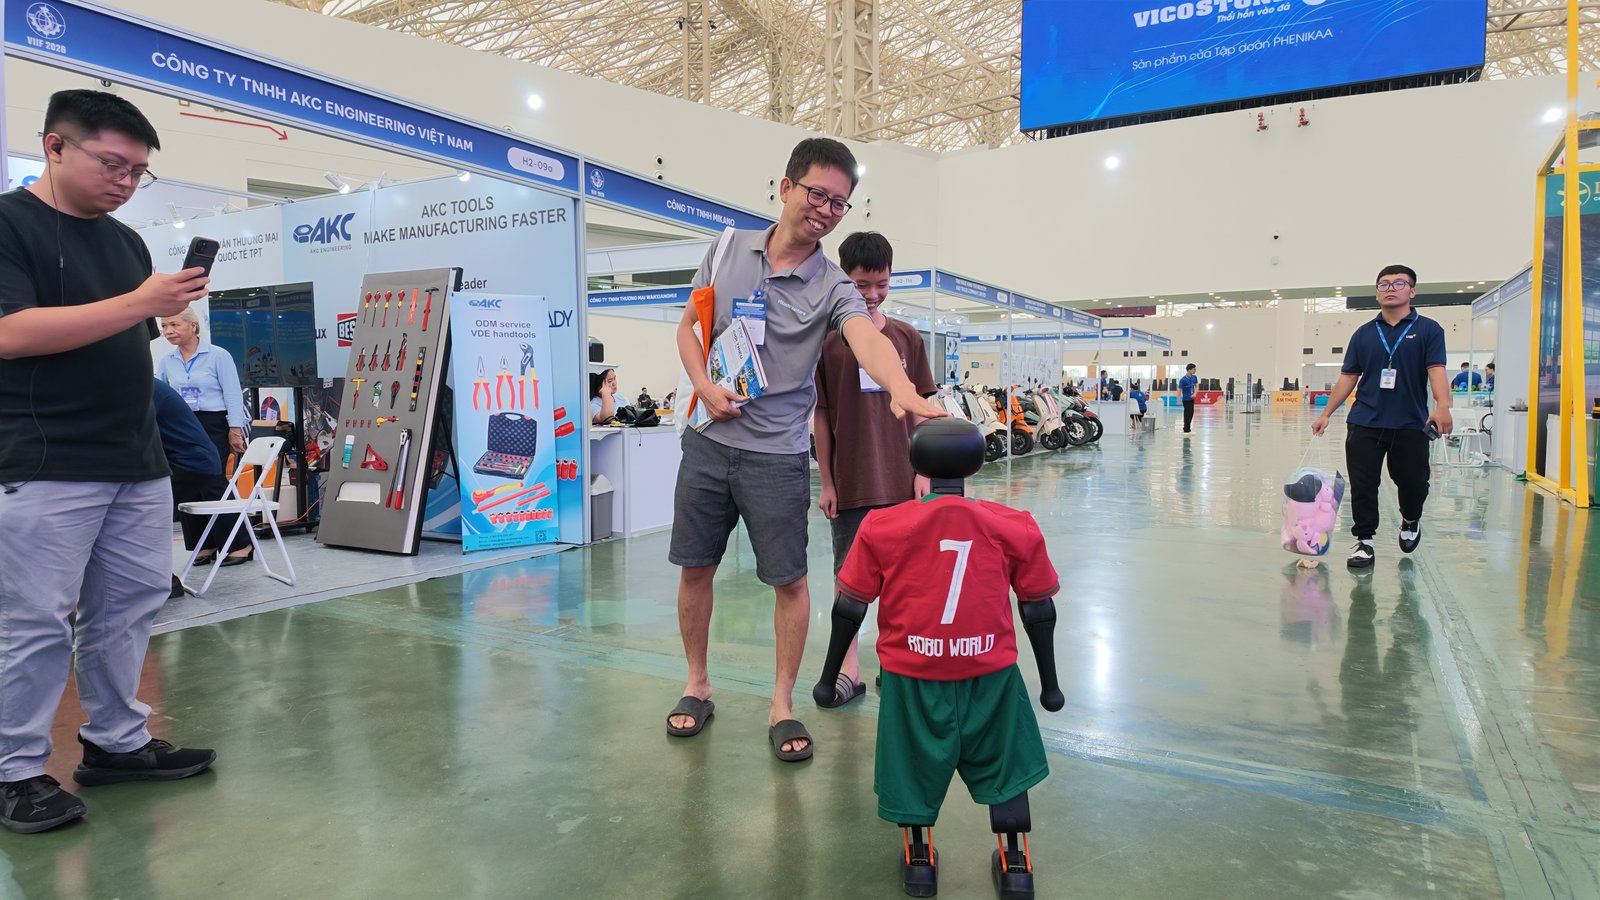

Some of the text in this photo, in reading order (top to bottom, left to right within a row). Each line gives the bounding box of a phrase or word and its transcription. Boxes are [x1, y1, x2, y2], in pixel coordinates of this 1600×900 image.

[1133, 0, 1282, 28] VICOST
[1257, 6, 1275, 15] vào
[27, 36, 67, 54] VIIF 2026
[1132, 59, 1152, 70] Sản
[1153, 52, 1187, 68] phẩm
[1189, 49, 1212, 61] của
[1273, 28, 1334, 46] PHENIKAA
[151, 52, 474, 152] CÔNG TY TNHH AKC ENGINEERING VIỆT NAM
[522, 156, 553, 173] H2-09a
[421, 196, 494, 218] AKC TOOLS
[666, 199, 736, 226] CÔNG TY TNHH MIKANO
[310, 212, 356, 244] AKC
[363, 208, 567, 244] MAKE MANUFACTURING FASTER
[250, 248, 263, 259] TPT
[460, 277, 488, 290] eader
[478, 299, 503, 309] AKC
[339, 320, 356, 339] BES
[471, 329, 537, 339] VDE handtools
[475, 320, 531, 329] ODM service
[939, 539, 973, 625] 7
[907, 633, 995, 657] ROBO WORLD
